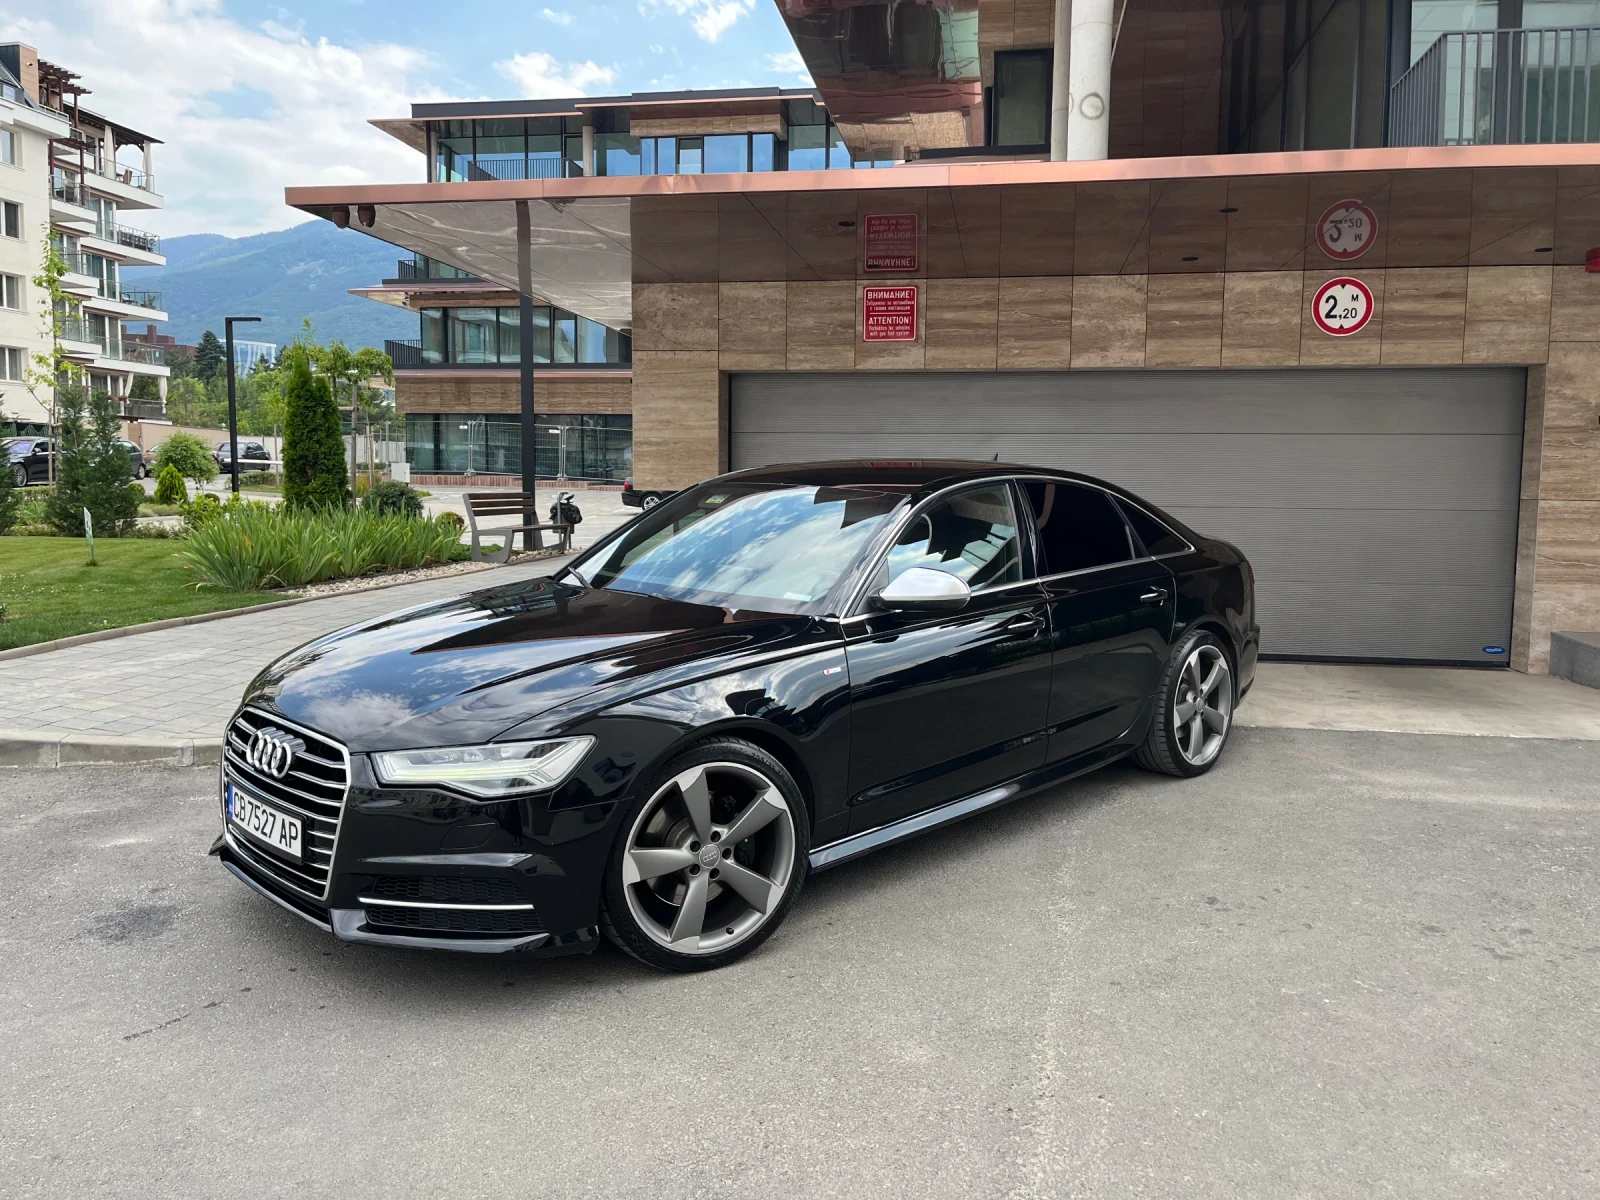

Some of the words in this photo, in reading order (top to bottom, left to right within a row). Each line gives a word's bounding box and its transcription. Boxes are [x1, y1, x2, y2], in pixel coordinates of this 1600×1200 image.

[867, 291, 913, 299] ВНИМАНИЕ!
[1324, 294, 1358, 320] 2,20
[868, 316, 912, 324] ATTENTION!
[247, 799, 276, 839] 7527
[279, 818, 299, 849] AP
